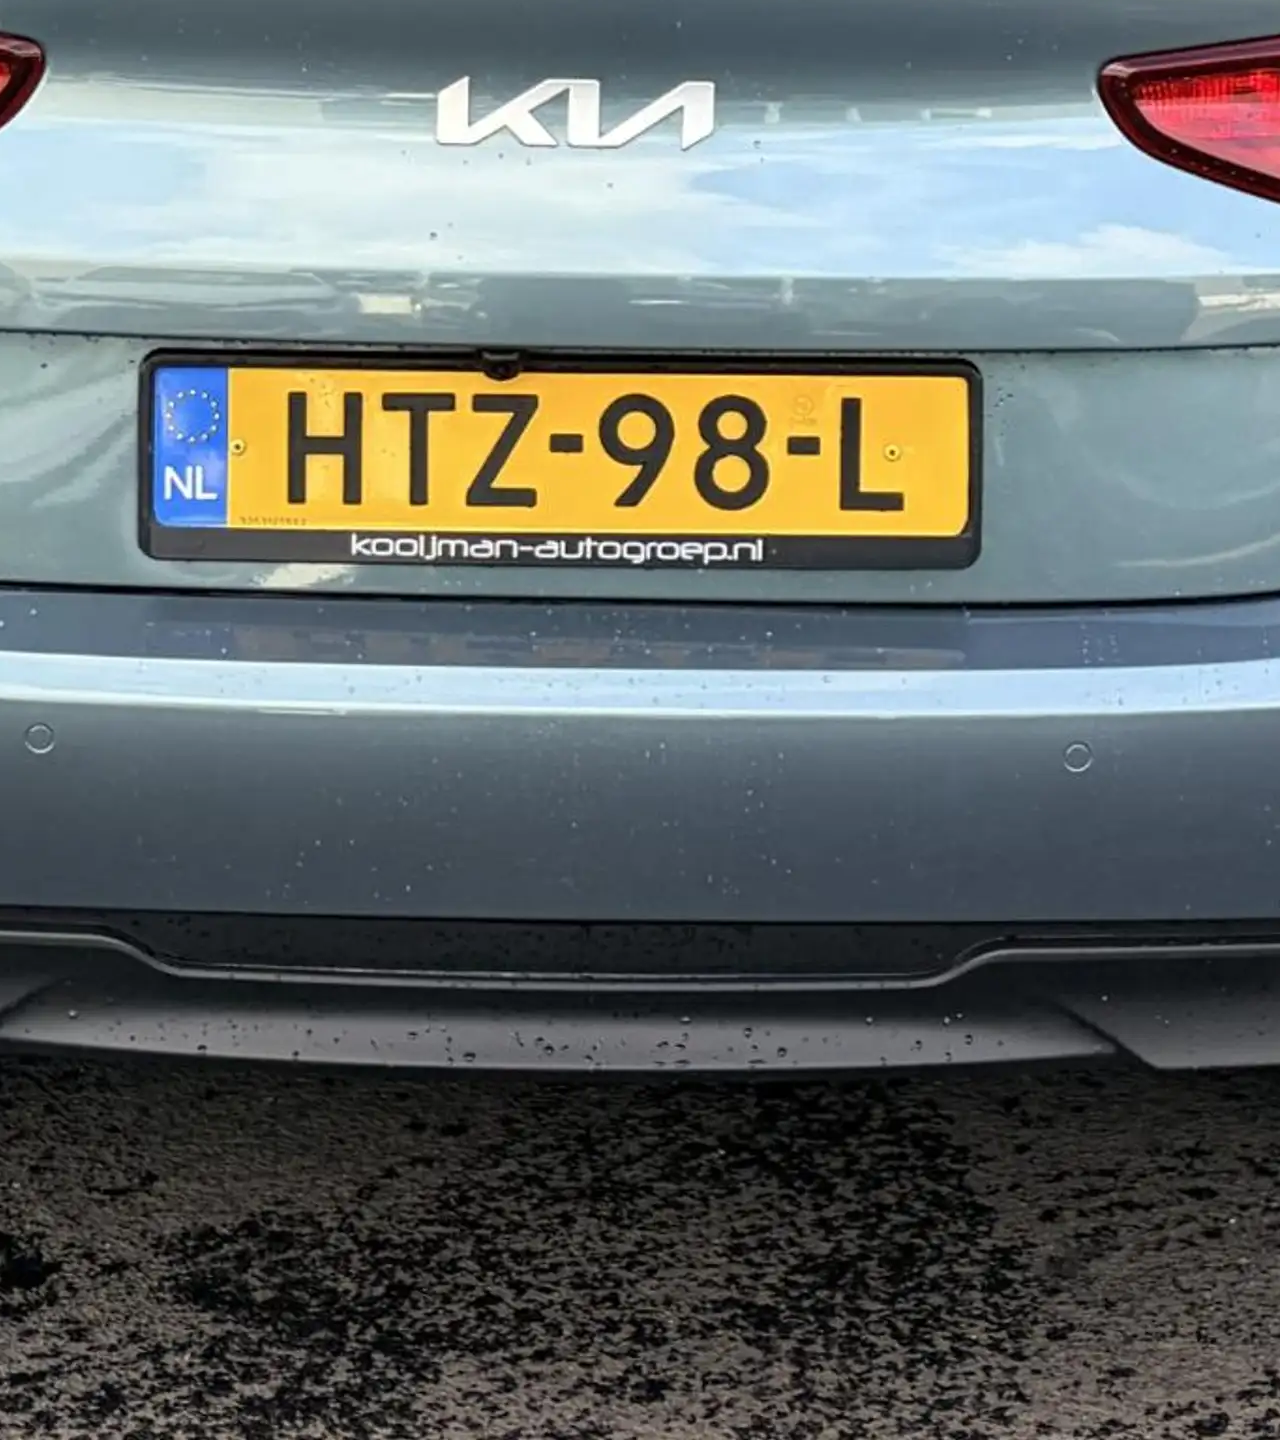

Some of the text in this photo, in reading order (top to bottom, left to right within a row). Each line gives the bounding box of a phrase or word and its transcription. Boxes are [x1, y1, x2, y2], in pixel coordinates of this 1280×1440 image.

[436, 75, 716, 151] KIA
[287, 391, 905, 512] HTZ-98-L
[163, 465, 219, 501] NL
[350, 533, 764, 563] kooijman-autogroep.nl
